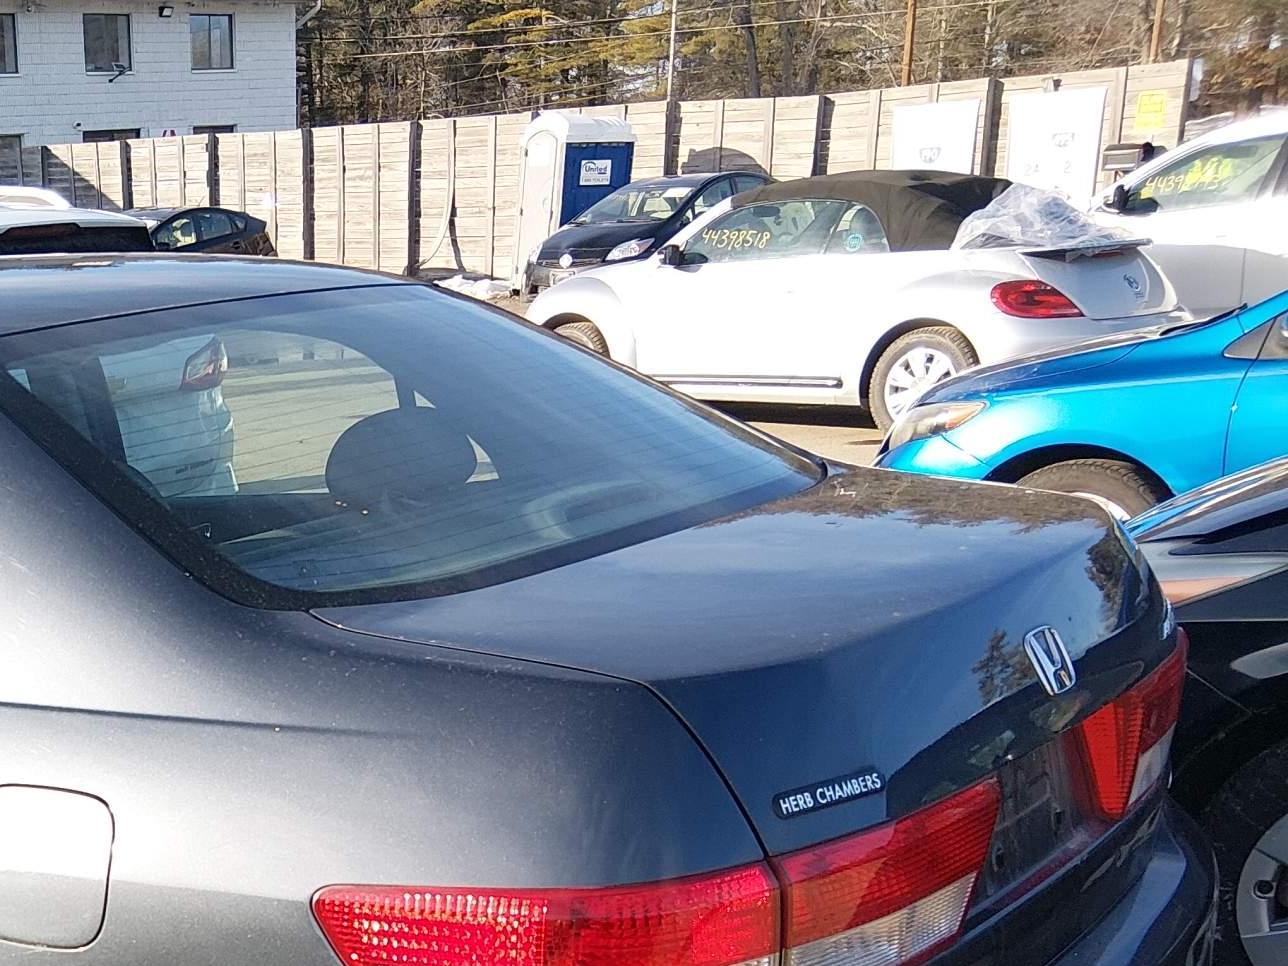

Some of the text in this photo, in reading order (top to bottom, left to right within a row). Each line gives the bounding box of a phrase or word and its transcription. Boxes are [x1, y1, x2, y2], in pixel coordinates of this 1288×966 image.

[584, 164, 608, 173] United
[702, 228, 771, 250] 44398518
[779, 773, 881, 815] HERB CHAMBERS
